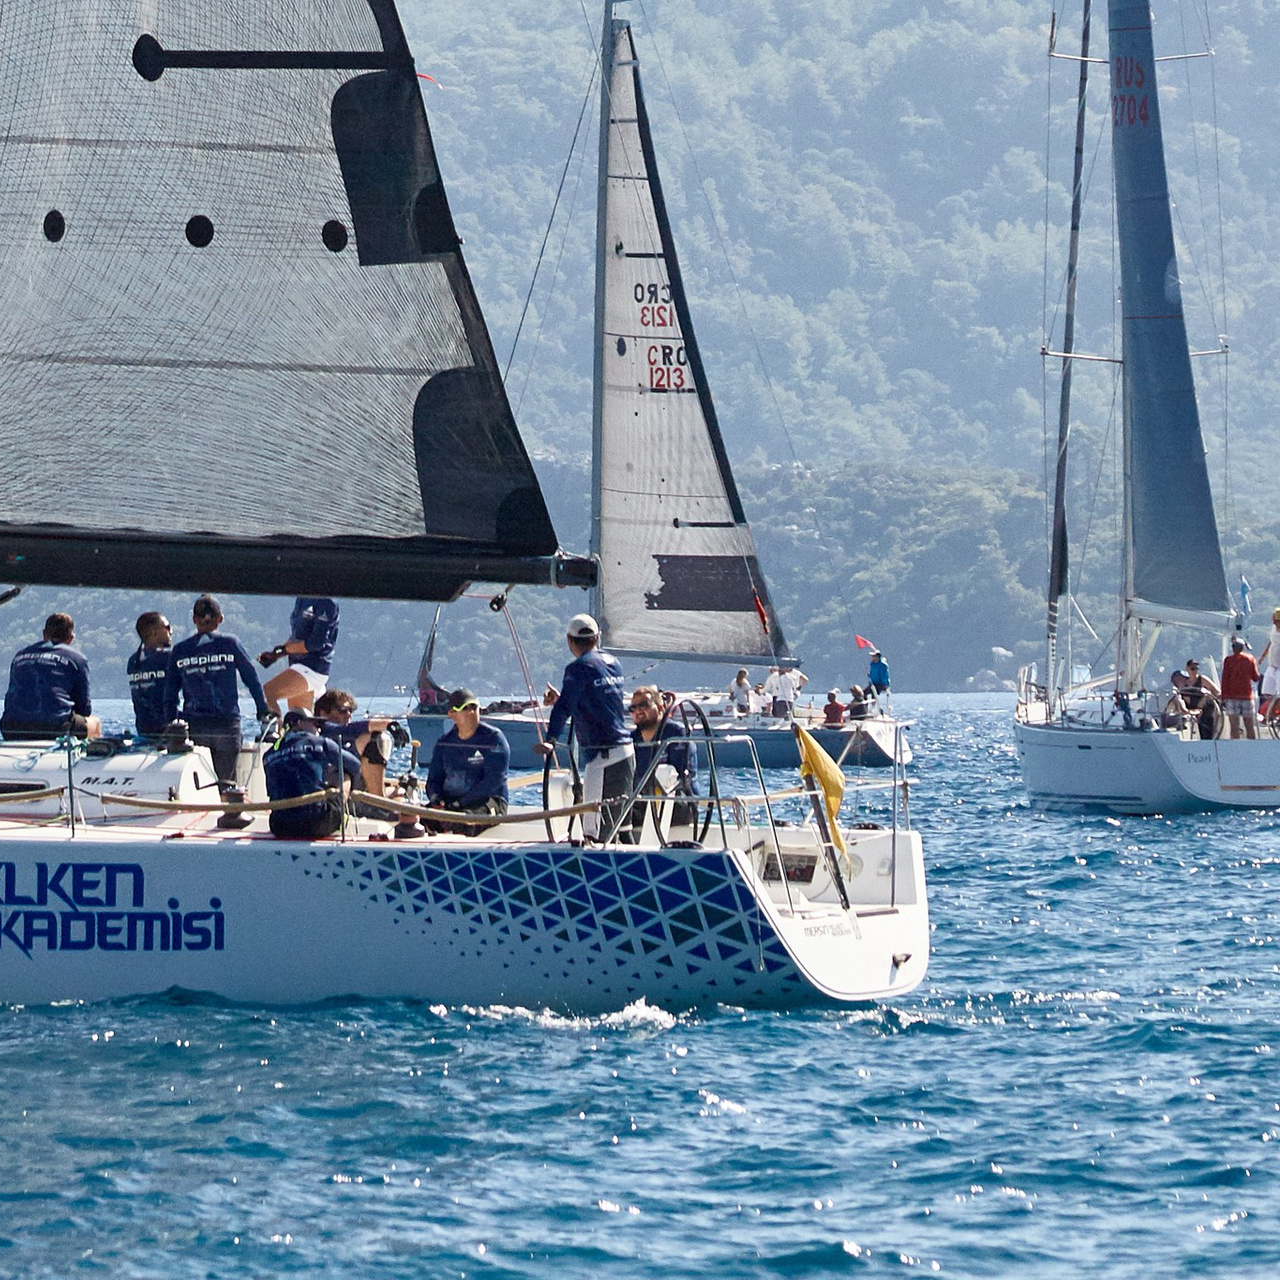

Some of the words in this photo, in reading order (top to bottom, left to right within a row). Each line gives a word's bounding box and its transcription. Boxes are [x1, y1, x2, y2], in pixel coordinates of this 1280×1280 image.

[648, 345, 688, 366] CRO
[650, 367, 685, 389] 1213
[176, 654, 235, 669] caspiana
